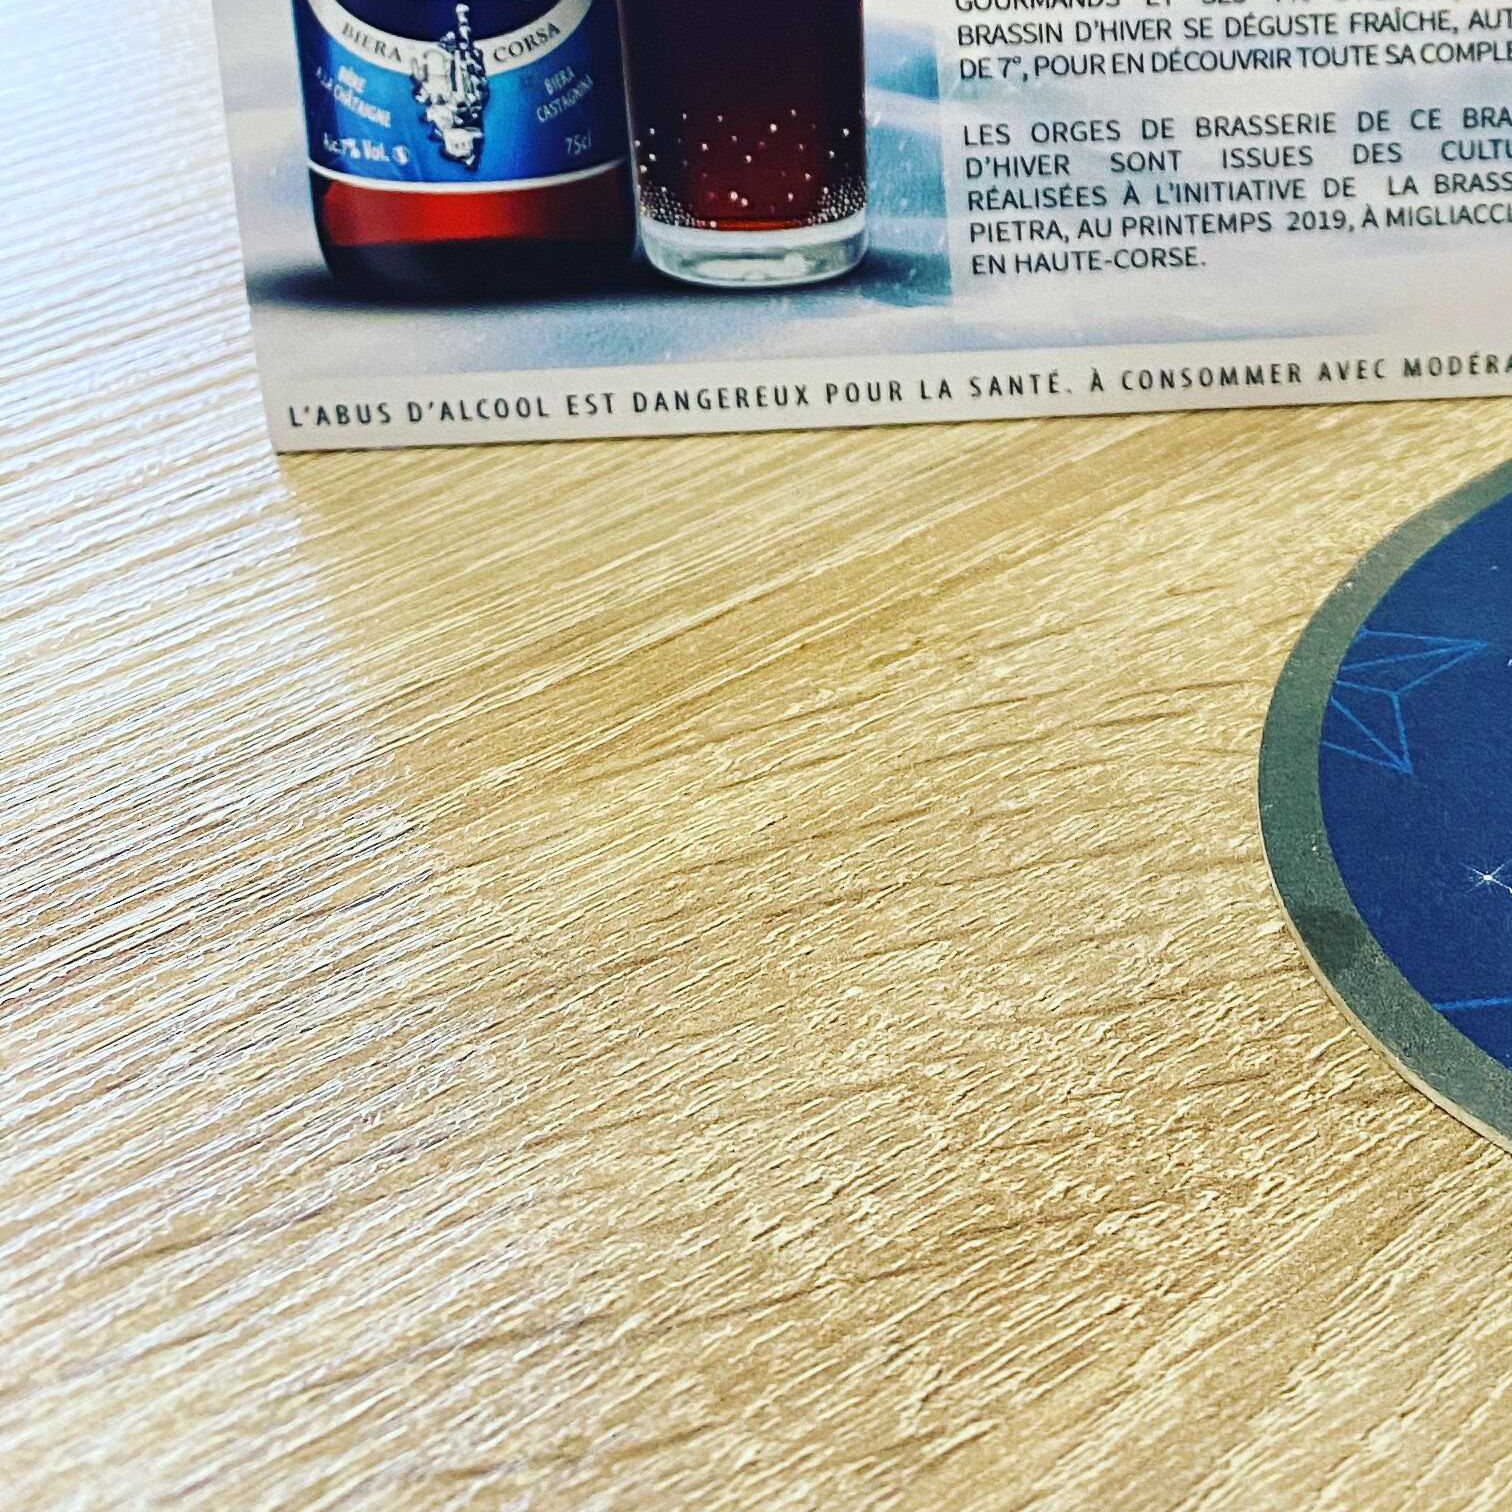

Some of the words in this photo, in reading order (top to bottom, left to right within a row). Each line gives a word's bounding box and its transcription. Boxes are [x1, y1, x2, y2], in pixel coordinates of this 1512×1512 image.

[341, 22, 403, 64] BIERA
[493, 21, 563, 65] CORSA
[957, 22, 1064, 48] BRASSIN
[1074, 18, 1173, 43] D'HIVER
[1183, 16, 1214, 40] SE
[1224, 11, 1339, 40] DÉGUSTE
[1349, 6, 1459, 35] FRAÎCHE,
[959, 57, 993, 82] DE
[1033, 53, 1106, 80] POUR
[1111, 51, 1145, 75] EN
[1150, 47, 1292, 74] DÉCOUVRIR
[1295, 44, 1379, 69] TOUTE
[1385, 43, 1417, 66] SA
[963, 123, 1011, 147] LES
[1030, 119, 1121, 145] ORGES
[1141, 117, 1175, 141] DE
[1195, 111, 1337, 139] BRASSERIE
[1357, 109, 1391, 134] DE
[1409, 107, 1442, 132] CE
[965, 153, 1071, 181] D'HIVER
[1109, 149, 1182, 174] SONT
[1222, 145, 1314, 170] ISSUES
[1352, 142, 1403, 166] DES
[967, 182, 1108, 212] RÉALISÉES
[1122, 179, 1141, 207] À
[1155, 178, 1306, 206] L'INITIATIVE
[1323, 176, 1357, 199] DE
[1387, 174, 1420, 197] LA
[969, 219, 1070, 245] PIETRA,
[1077, 217, 1112, 240] AU
[1121, 211, 1273, 239] PRINTEMPS
[1286, 209, 1355, 233] 2019,
[1360, 203, 1380, 229] À
[971, 254, 1007, 276] EN
[1014, 245, 1206, 275] HAUTE-CORSE.
[288, 402, 392, 428] L'ABUS
[406, 396, 550, 423] D'ALCOOL
[566, 392, 614, 417] EST
[632, 384, 809, 414] DANGEREUX
[825, 380, 903, 405] POUR
[920, 378, 953, 401] LA
[968, 369, 1074, 398] SANTÉ.
[1089, 367, 1105, 393] À
[1121, 362, 1302, 391] CONSOMMER
[1317, 358, 1386, 382] AVEC
